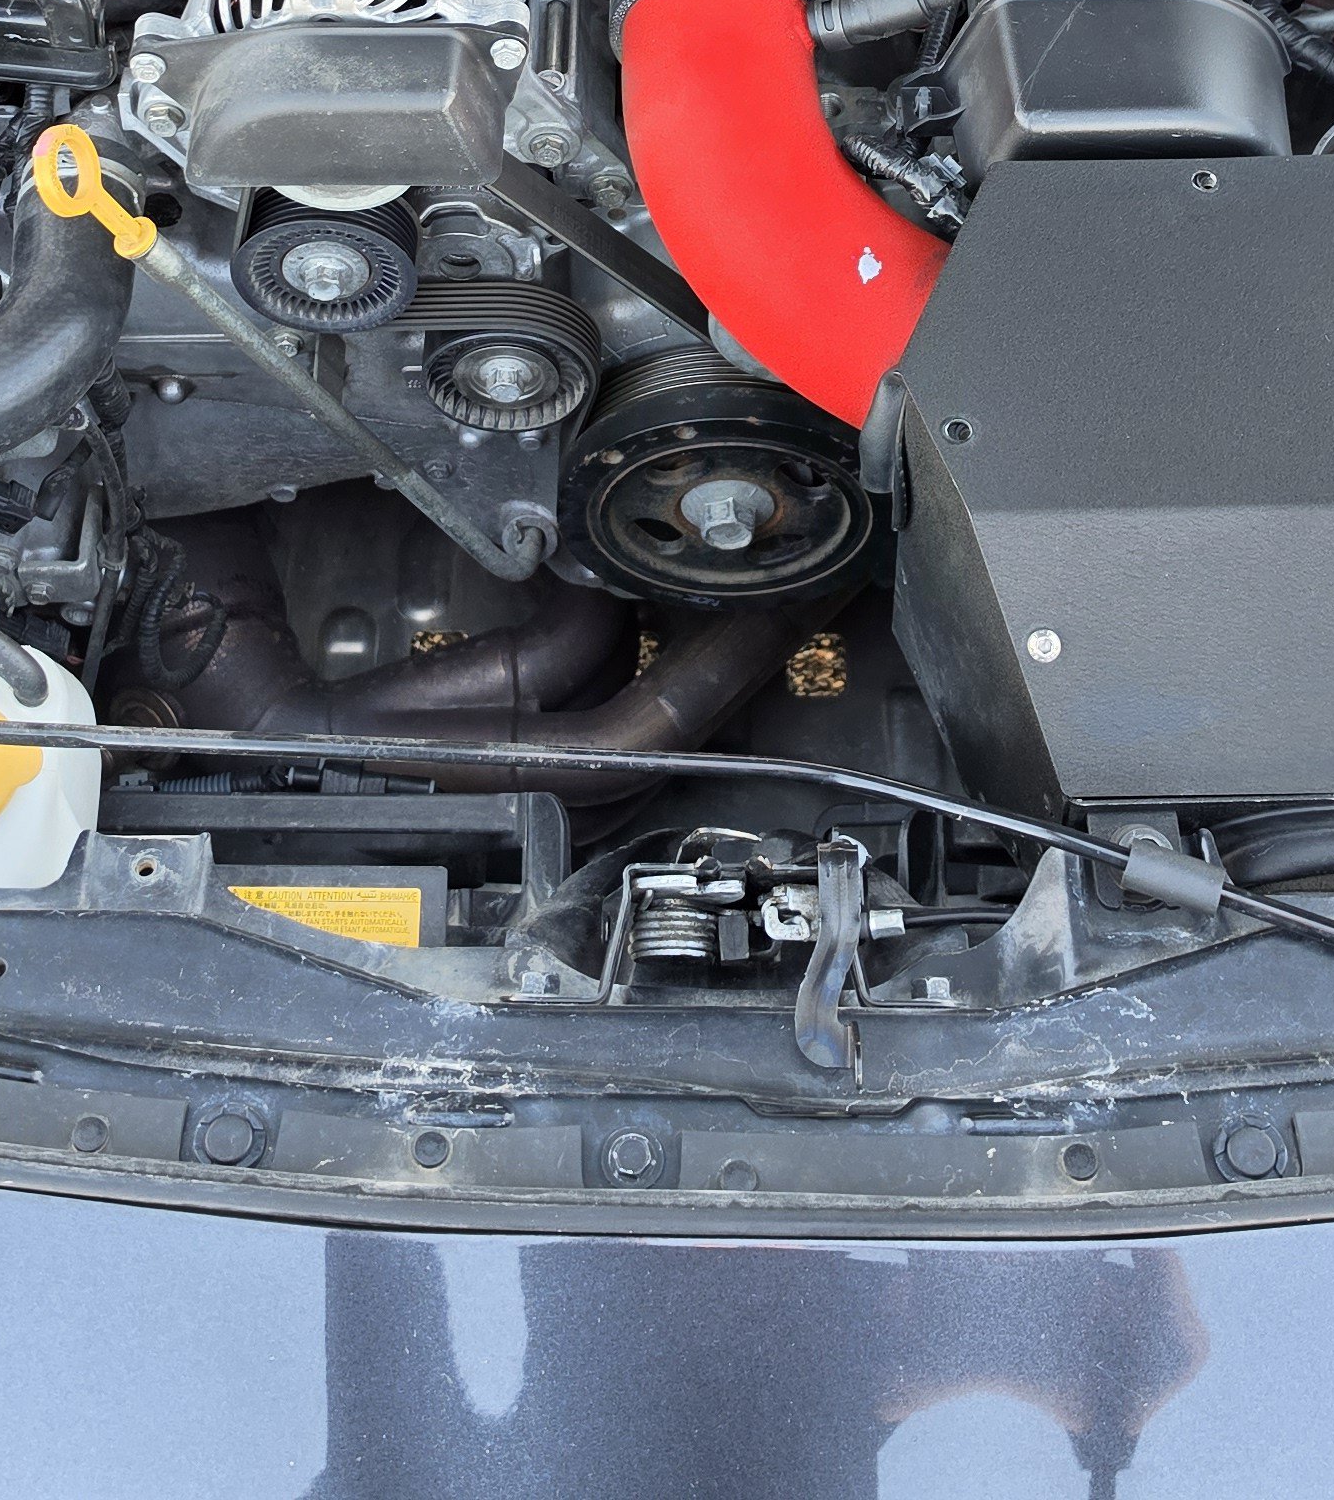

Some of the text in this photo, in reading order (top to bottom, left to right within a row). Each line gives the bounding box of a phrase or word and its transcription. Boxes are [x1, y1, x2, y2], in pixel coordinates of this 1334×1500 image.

[267, 891, 354, 901] CAUTION ATTENTION
[321, 918, 349, 926] STARTS
[349, 918, 409, 926] AUTOMATICALLY
